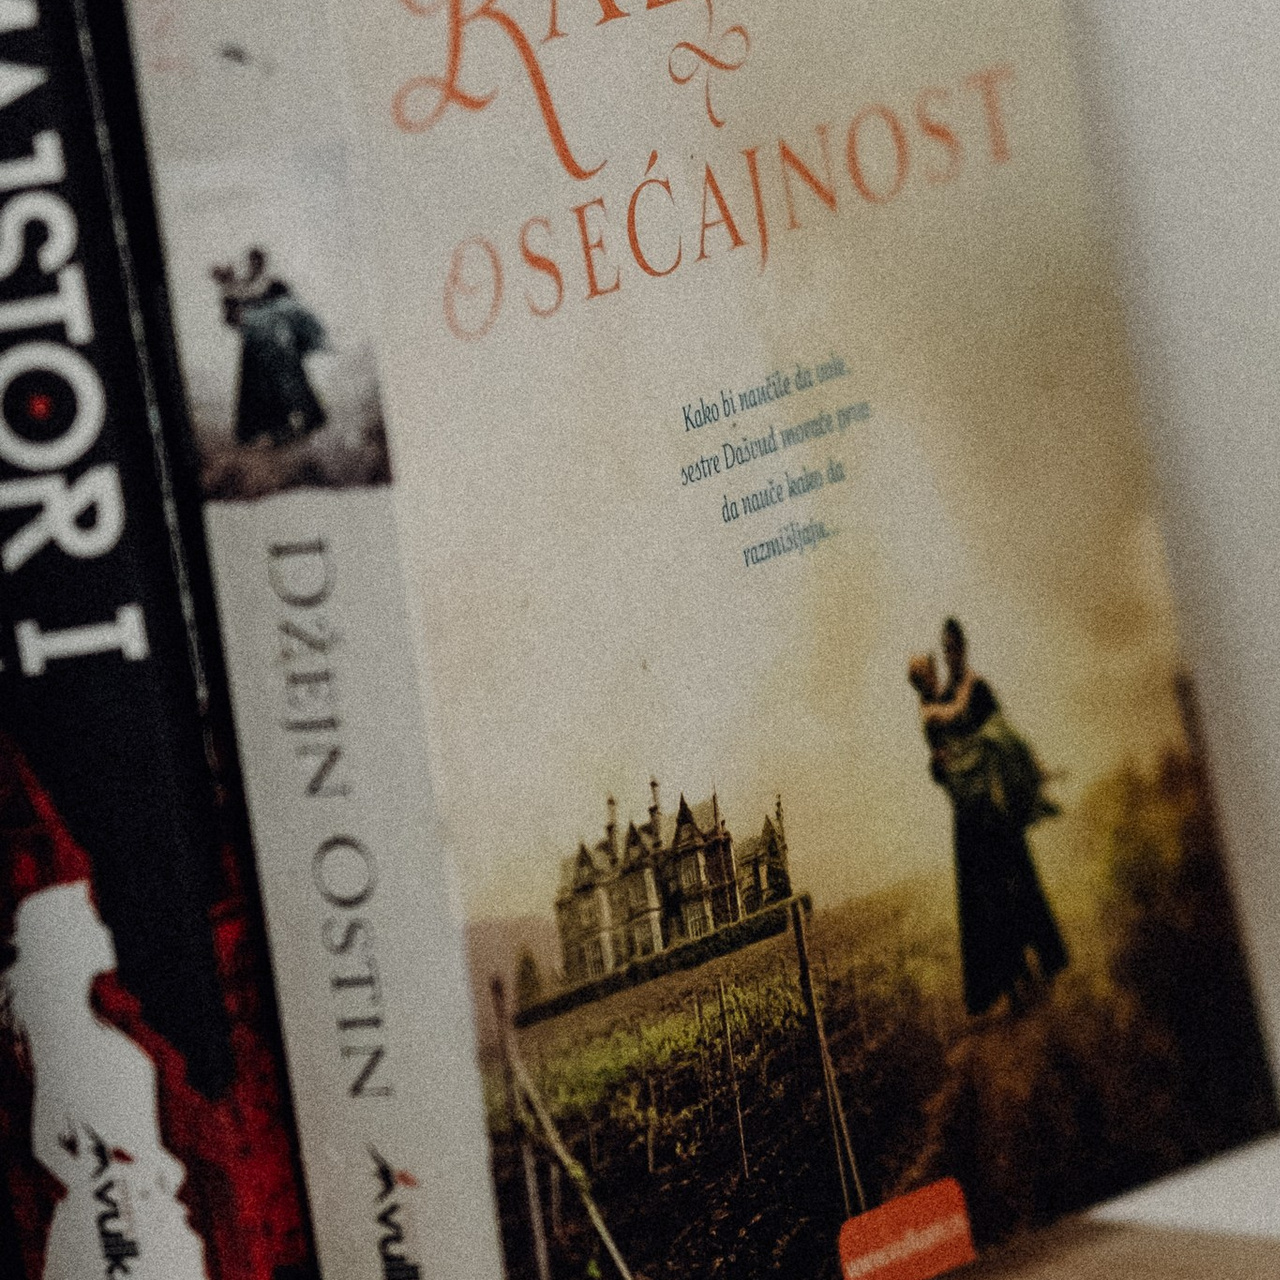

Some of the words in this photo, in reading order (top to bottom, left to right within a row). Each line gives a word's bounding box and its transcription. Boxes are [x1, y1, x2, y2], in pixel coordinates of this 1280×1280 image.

[443, 63, 1018, 341] OSEĆAJNOST
[682, 398, 720, 432] Kako
[720, 390, 738, 418] bi
[738, 370, 791, 411] naučile
[794, 363, 815, 391] da
[680, 454, 721, 486] sestre
[722, 425, 778, 470] Dašvud
[722, 494, 739, 523] da
[742, 479, 785, 515] nauče
[785, 465, 825, 500] kako
[826, 458, 846, 485] da
[267, 538, 351, 798] DŽEJN
[311, 833, 395, 1100] OSTIN
